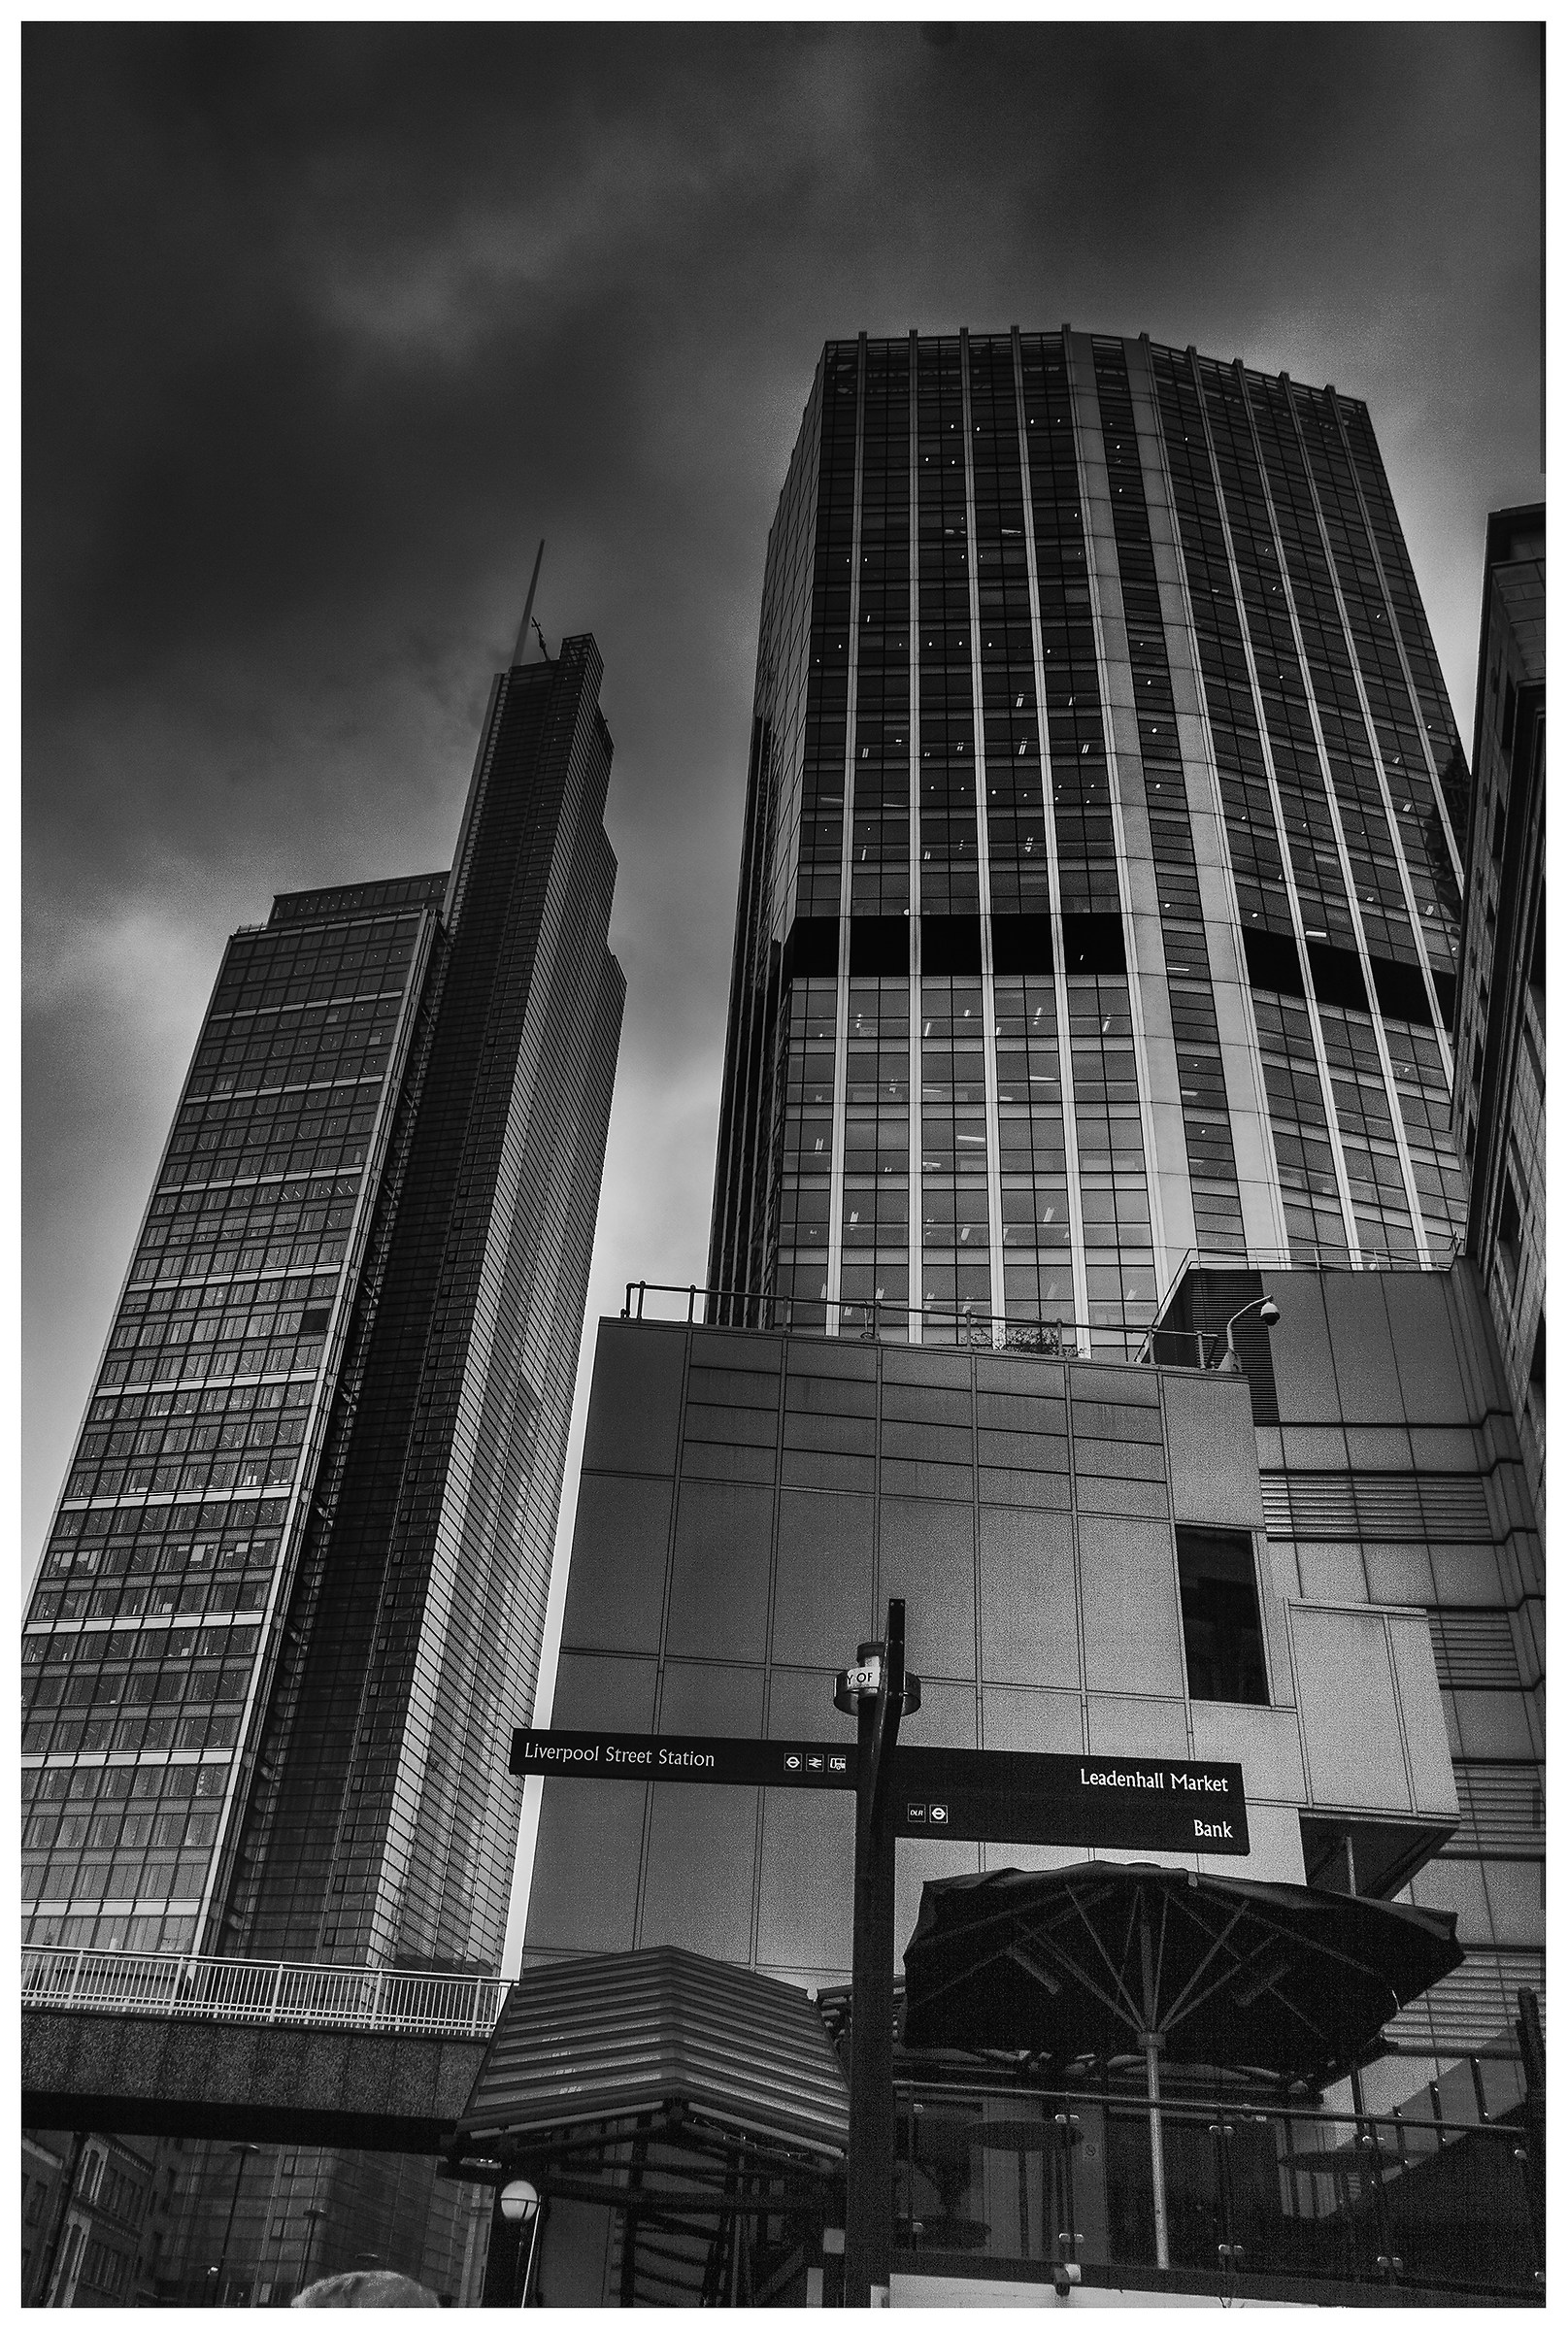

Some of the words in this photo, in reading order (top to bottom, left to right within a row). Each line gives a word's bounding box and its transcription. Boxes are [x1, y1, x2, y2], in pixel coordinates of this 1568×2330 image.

[856, 1672, 873, 1683] OF
[524, 1742, 600, 1763] Liverpool
[605, 1746, 652, 1764] Street
[658, 1748, 715, 1767] Station
[1080, 1768, 1164, 1789] Leadenhall
[1169, 1773, 1229, 1792] Market
[1193, 1818, 1234, 1839] Bank
